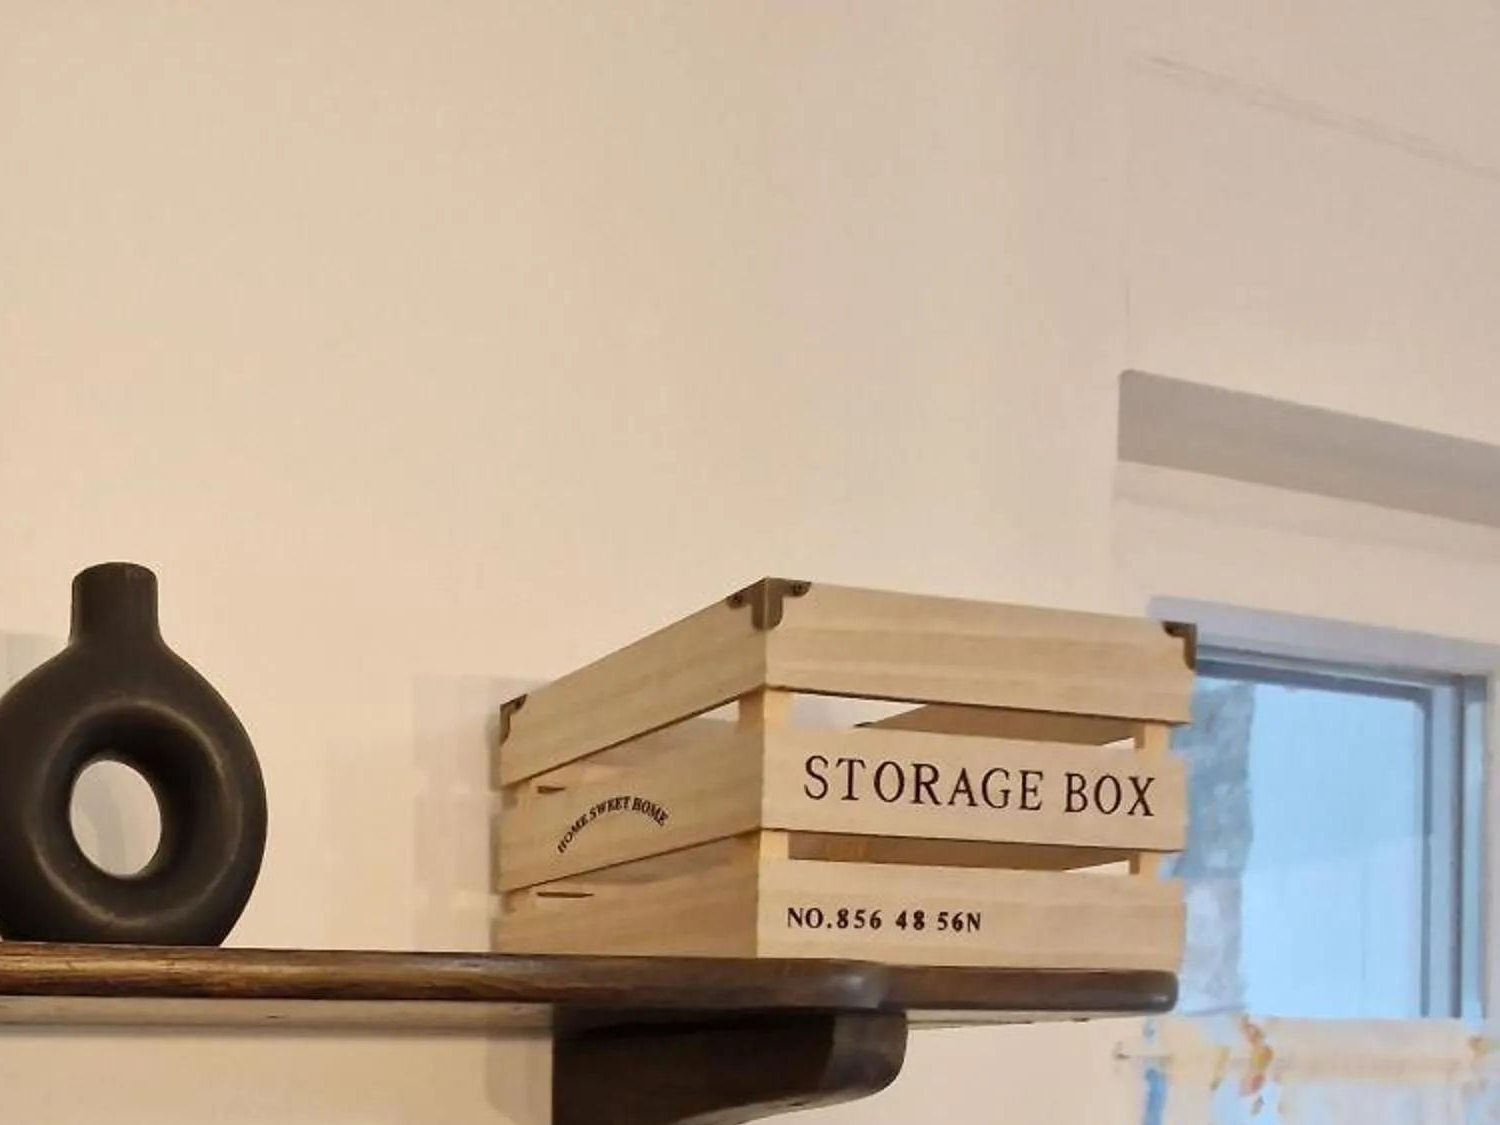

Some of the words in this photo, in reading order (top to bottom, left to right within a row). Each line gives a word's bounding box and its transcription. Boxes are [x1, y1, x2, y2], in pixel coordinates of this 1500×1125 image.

[803, 754, 1044, 812] STORAGE
[1064, 772, 1156, 817] BOX
[556, 813, 589, 854] HOME
[589, 795, 631, 821] SWEET
[631, 796, 669, 827] HOME
[787, 907, 883, 930] NO.856
[895, 909, 925, 931] 48
[937, 911, 981, 933] 56N
